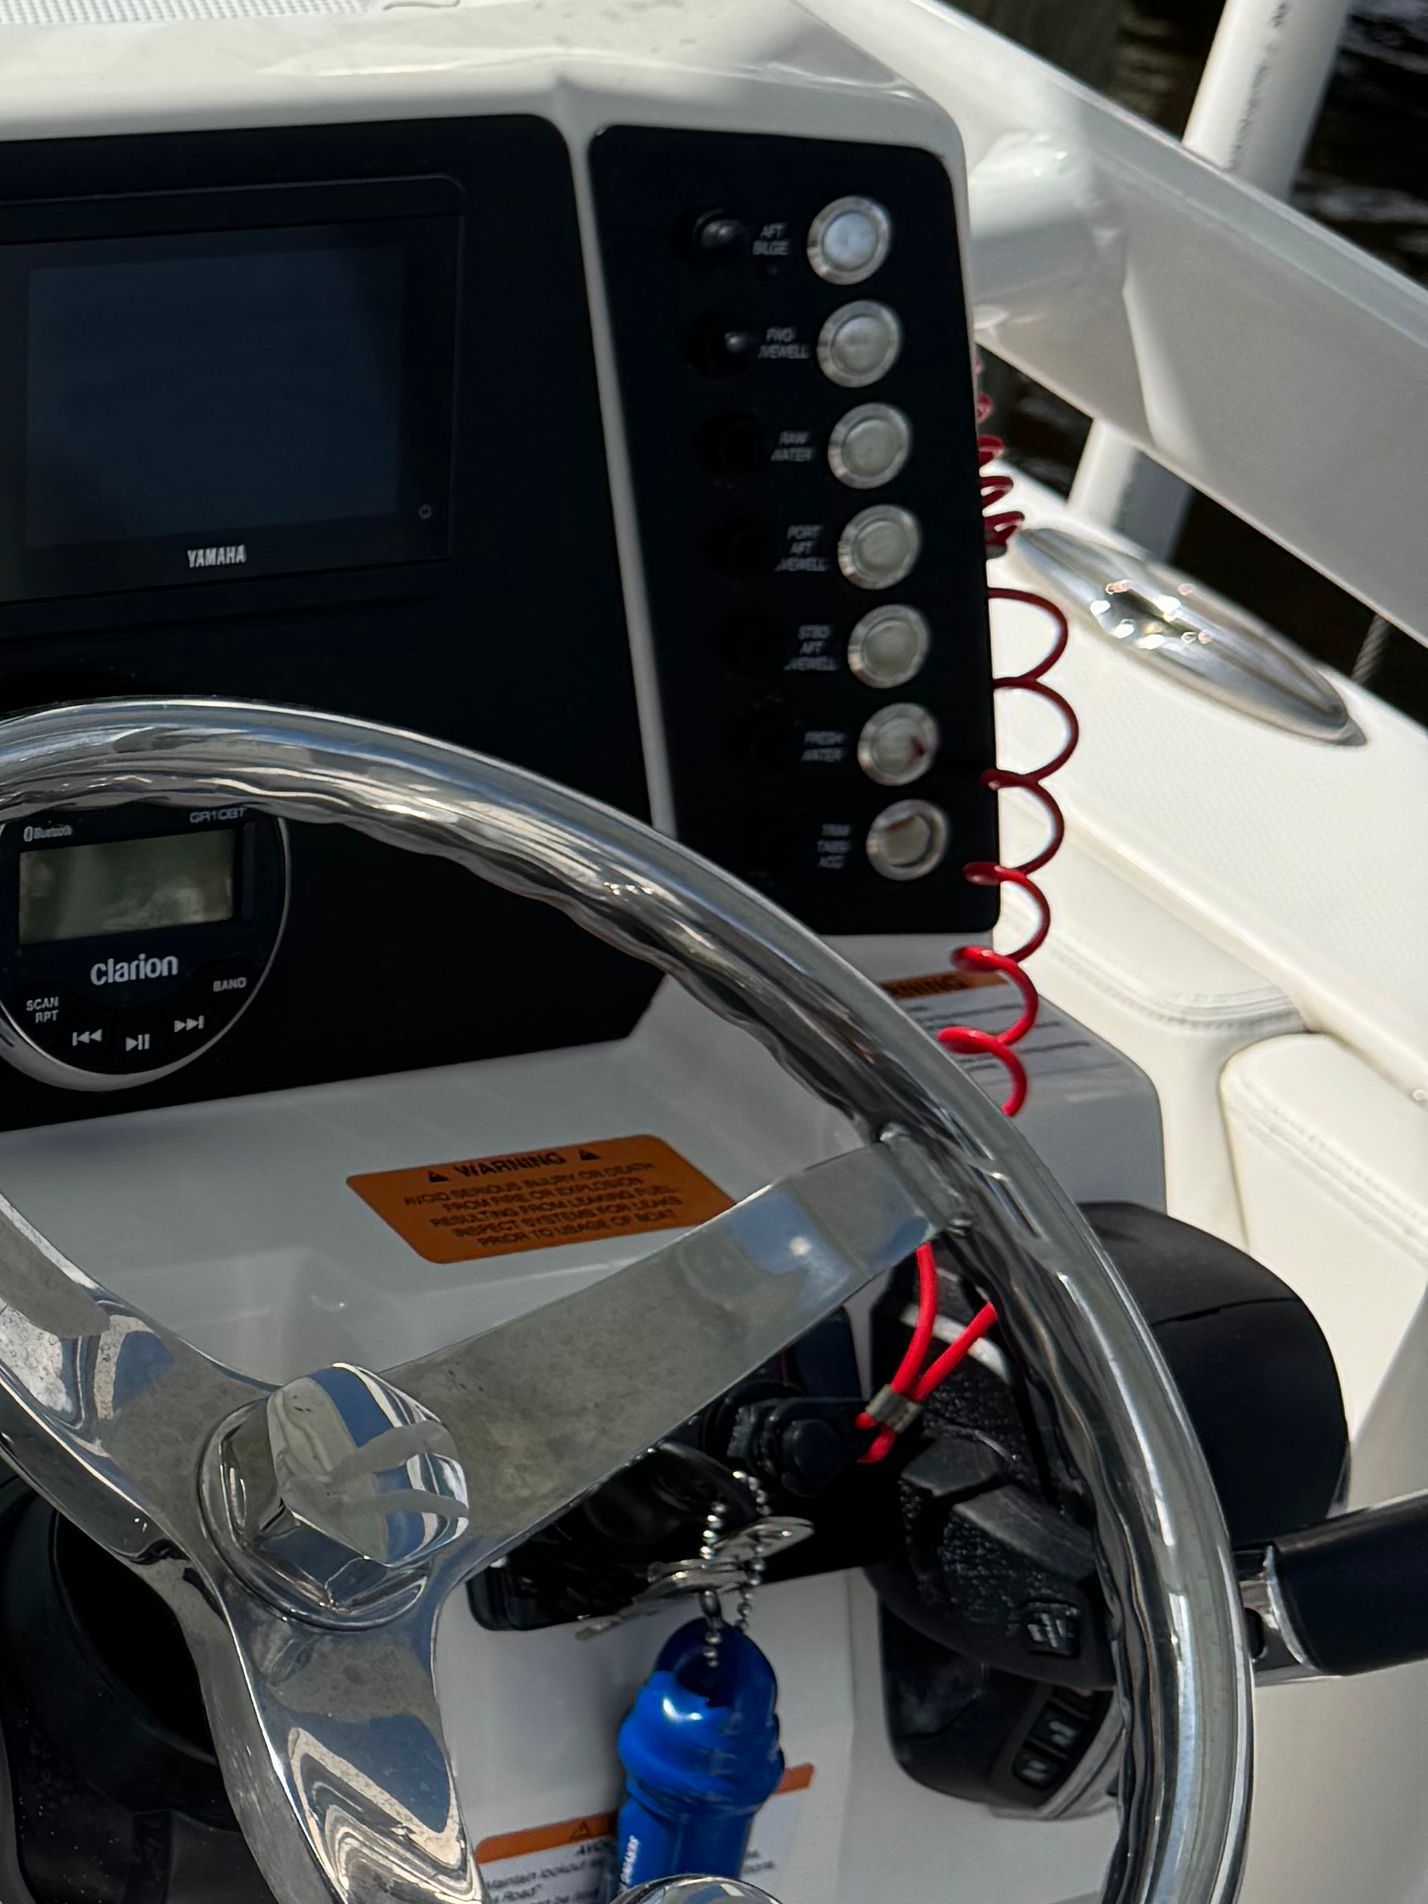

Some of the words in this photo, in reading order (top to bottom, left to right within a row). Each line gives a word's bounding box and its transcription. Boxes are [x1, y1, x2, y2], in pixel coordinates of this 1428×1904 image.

[187, 544, 247, 568] YAMAHA
[89, 953, 179, 987] Clarion
[212, 976, 247, 992] BAND
[26, 996, 59, 1012] SCAN
[454, 1149, 567, 1179] WARNING
